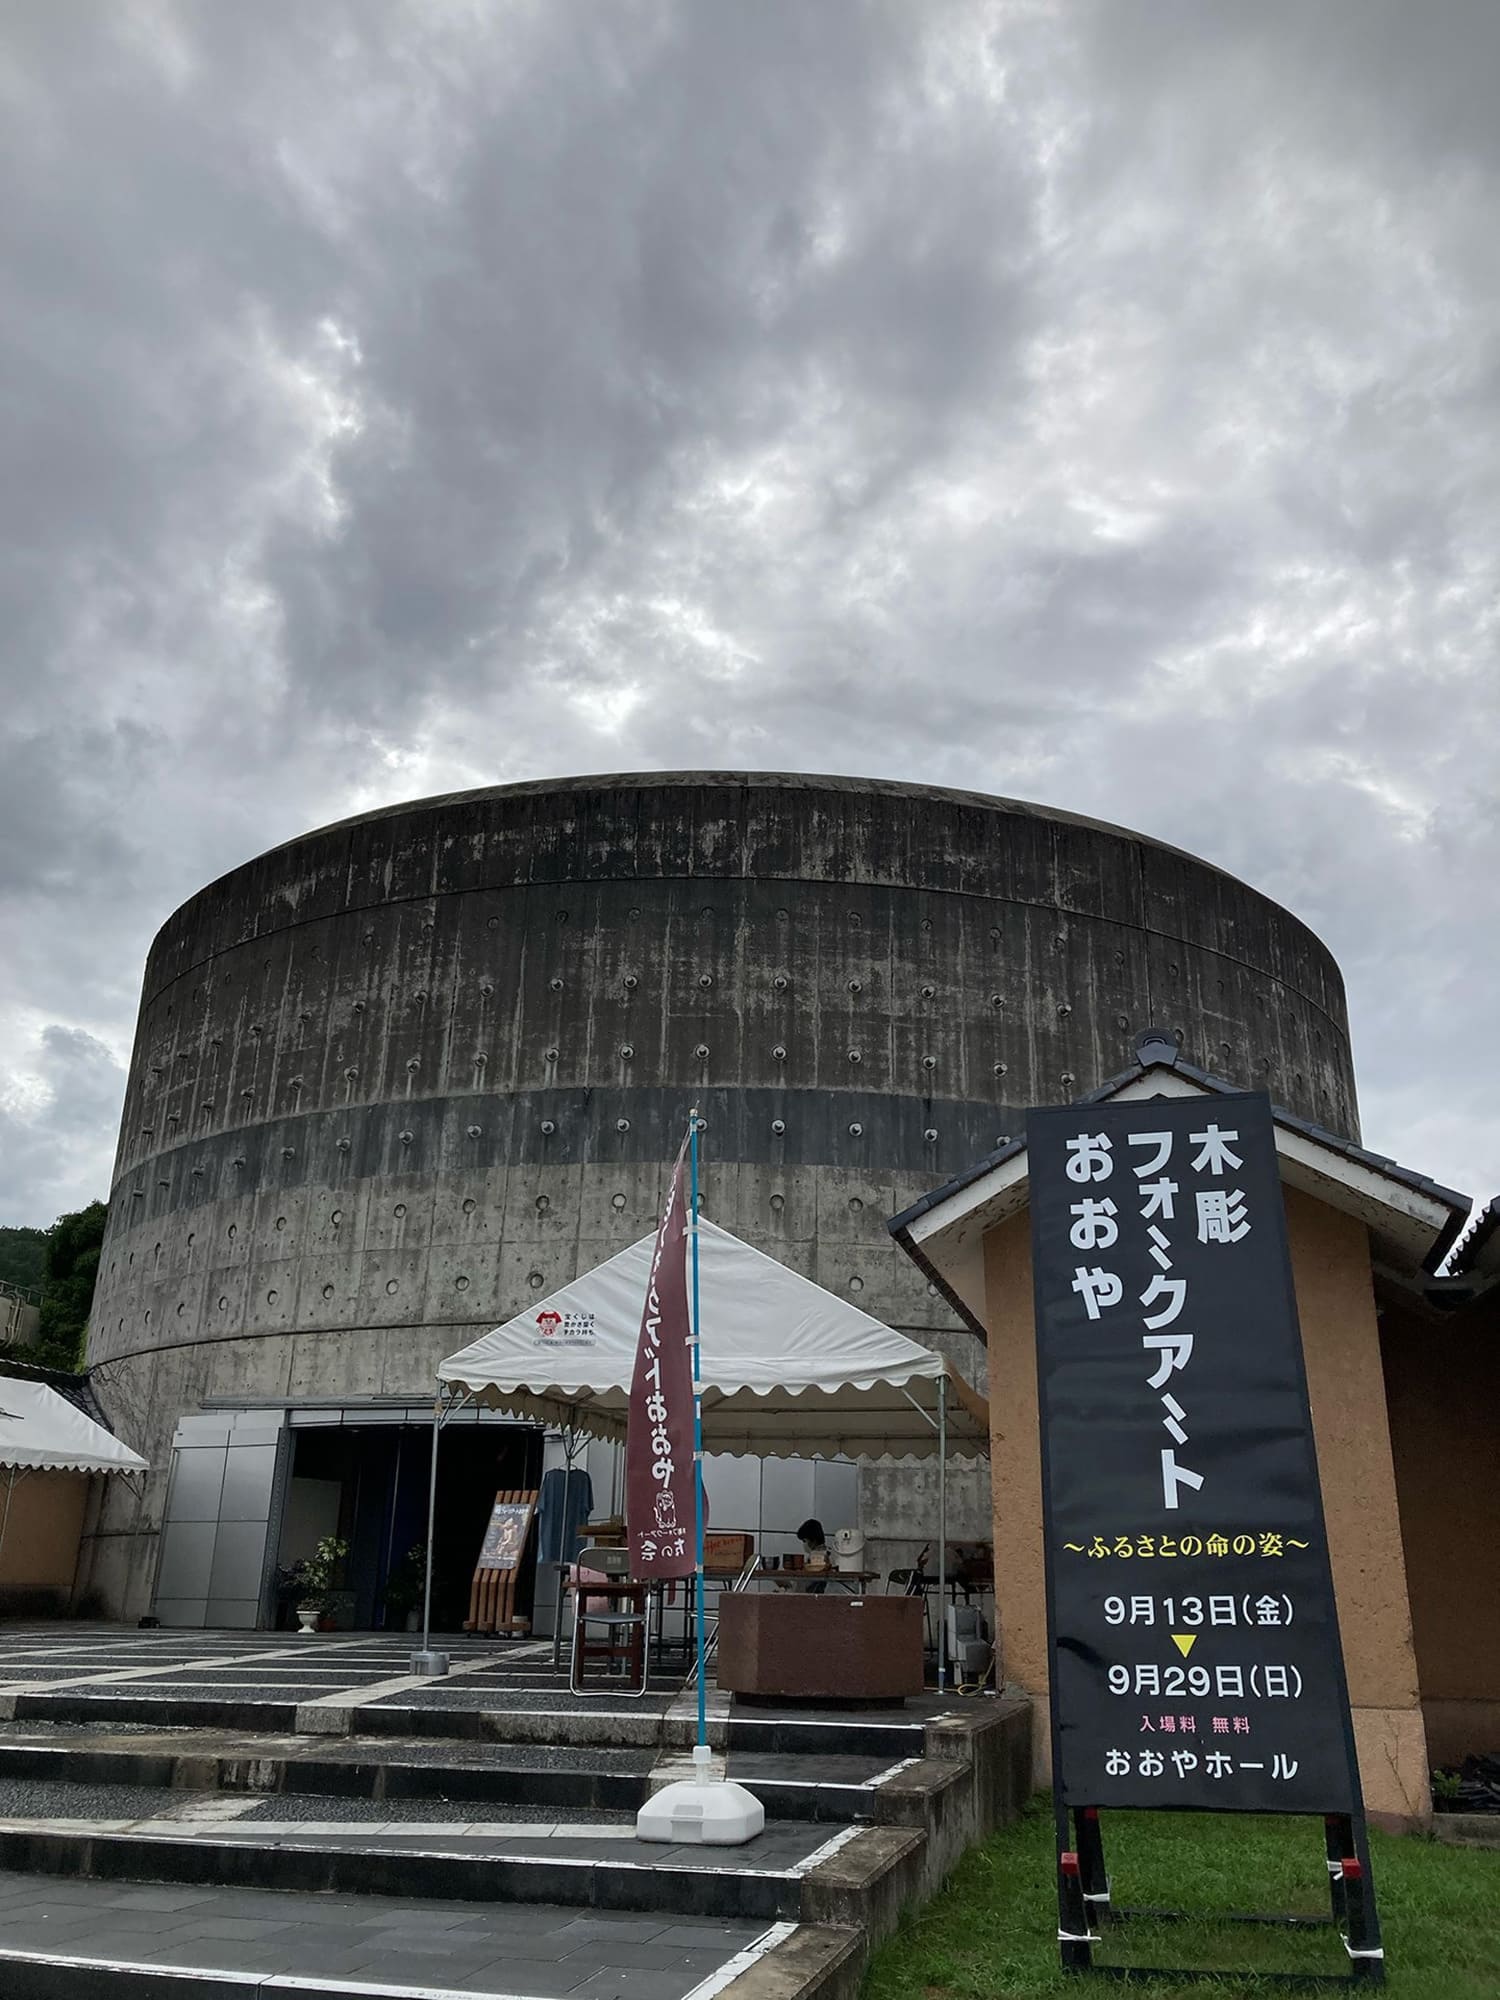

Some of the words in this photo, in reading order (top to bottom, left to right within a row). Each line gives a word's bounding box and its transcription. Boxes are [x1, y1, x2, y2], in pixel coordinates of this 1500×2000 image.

[1065, 1133, 1122, 1320] おおや
[1189, 1125, 1251, 1244] 木彫
[1128, 1132, 1204, 1509] フォークアート
[1105, 1749, 1298, 1780] おおやホール
[1140, 1716, 1196, 1733] 入場料
[1212, 1716, 1250, 1734] 無料
